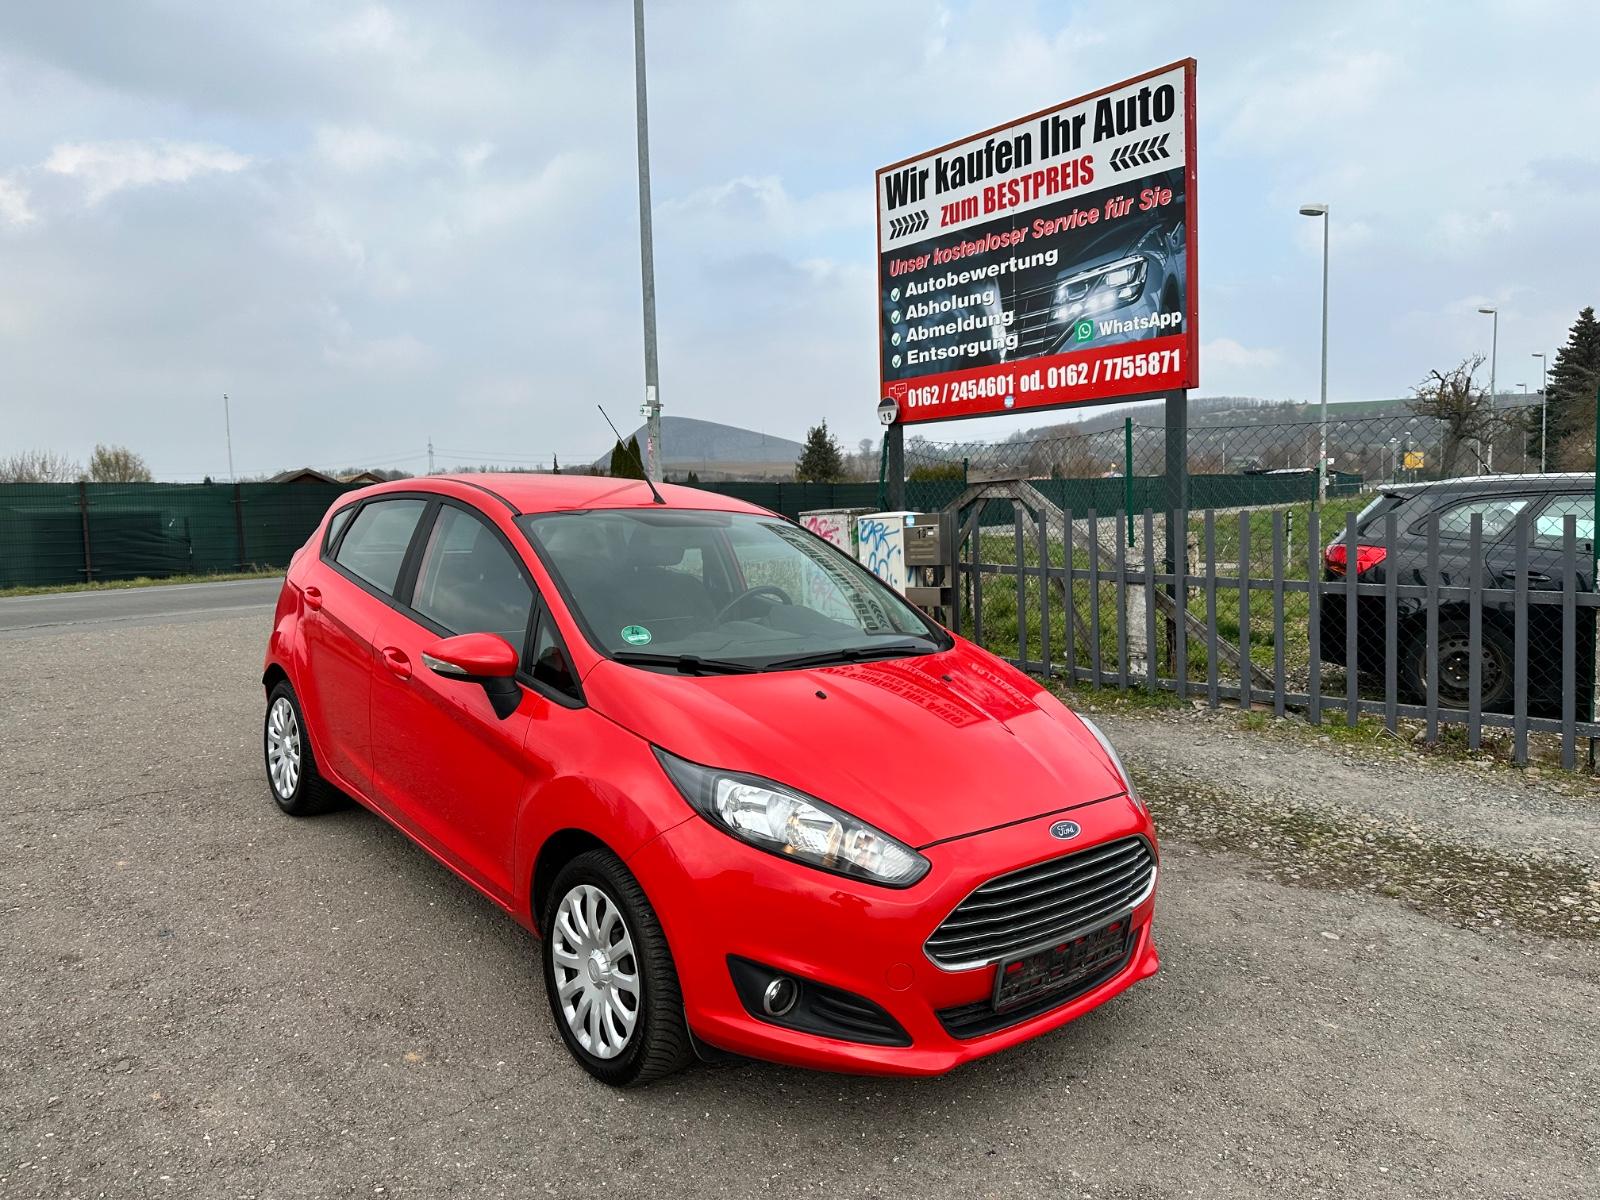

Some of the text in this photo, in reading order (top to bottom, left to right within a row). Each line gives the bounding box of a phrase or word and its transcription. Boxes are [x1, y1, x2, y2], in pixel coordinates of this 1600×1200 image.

[885, 84, 1175, 210] Wir kaufen Ihr Auto
[940, 154, 1094, 228] zum BESTPREIS
[889, 186, 1173, 277] Unser kostenloser Service für Sie
[904, 248, 1059, 298] Autobewertung
[905, 289, 995, 321] Abholung
[905, 309, 1015, 343] Abmeldung
[1099, 311, 1182, 336] WhatsApp
[907, 333, 1019, 365] Entsorgung
[908, 348, 1181, 408] 0162 / 2454601 od. 0162 / 7755871
[883, 411, 892, 421] 19
